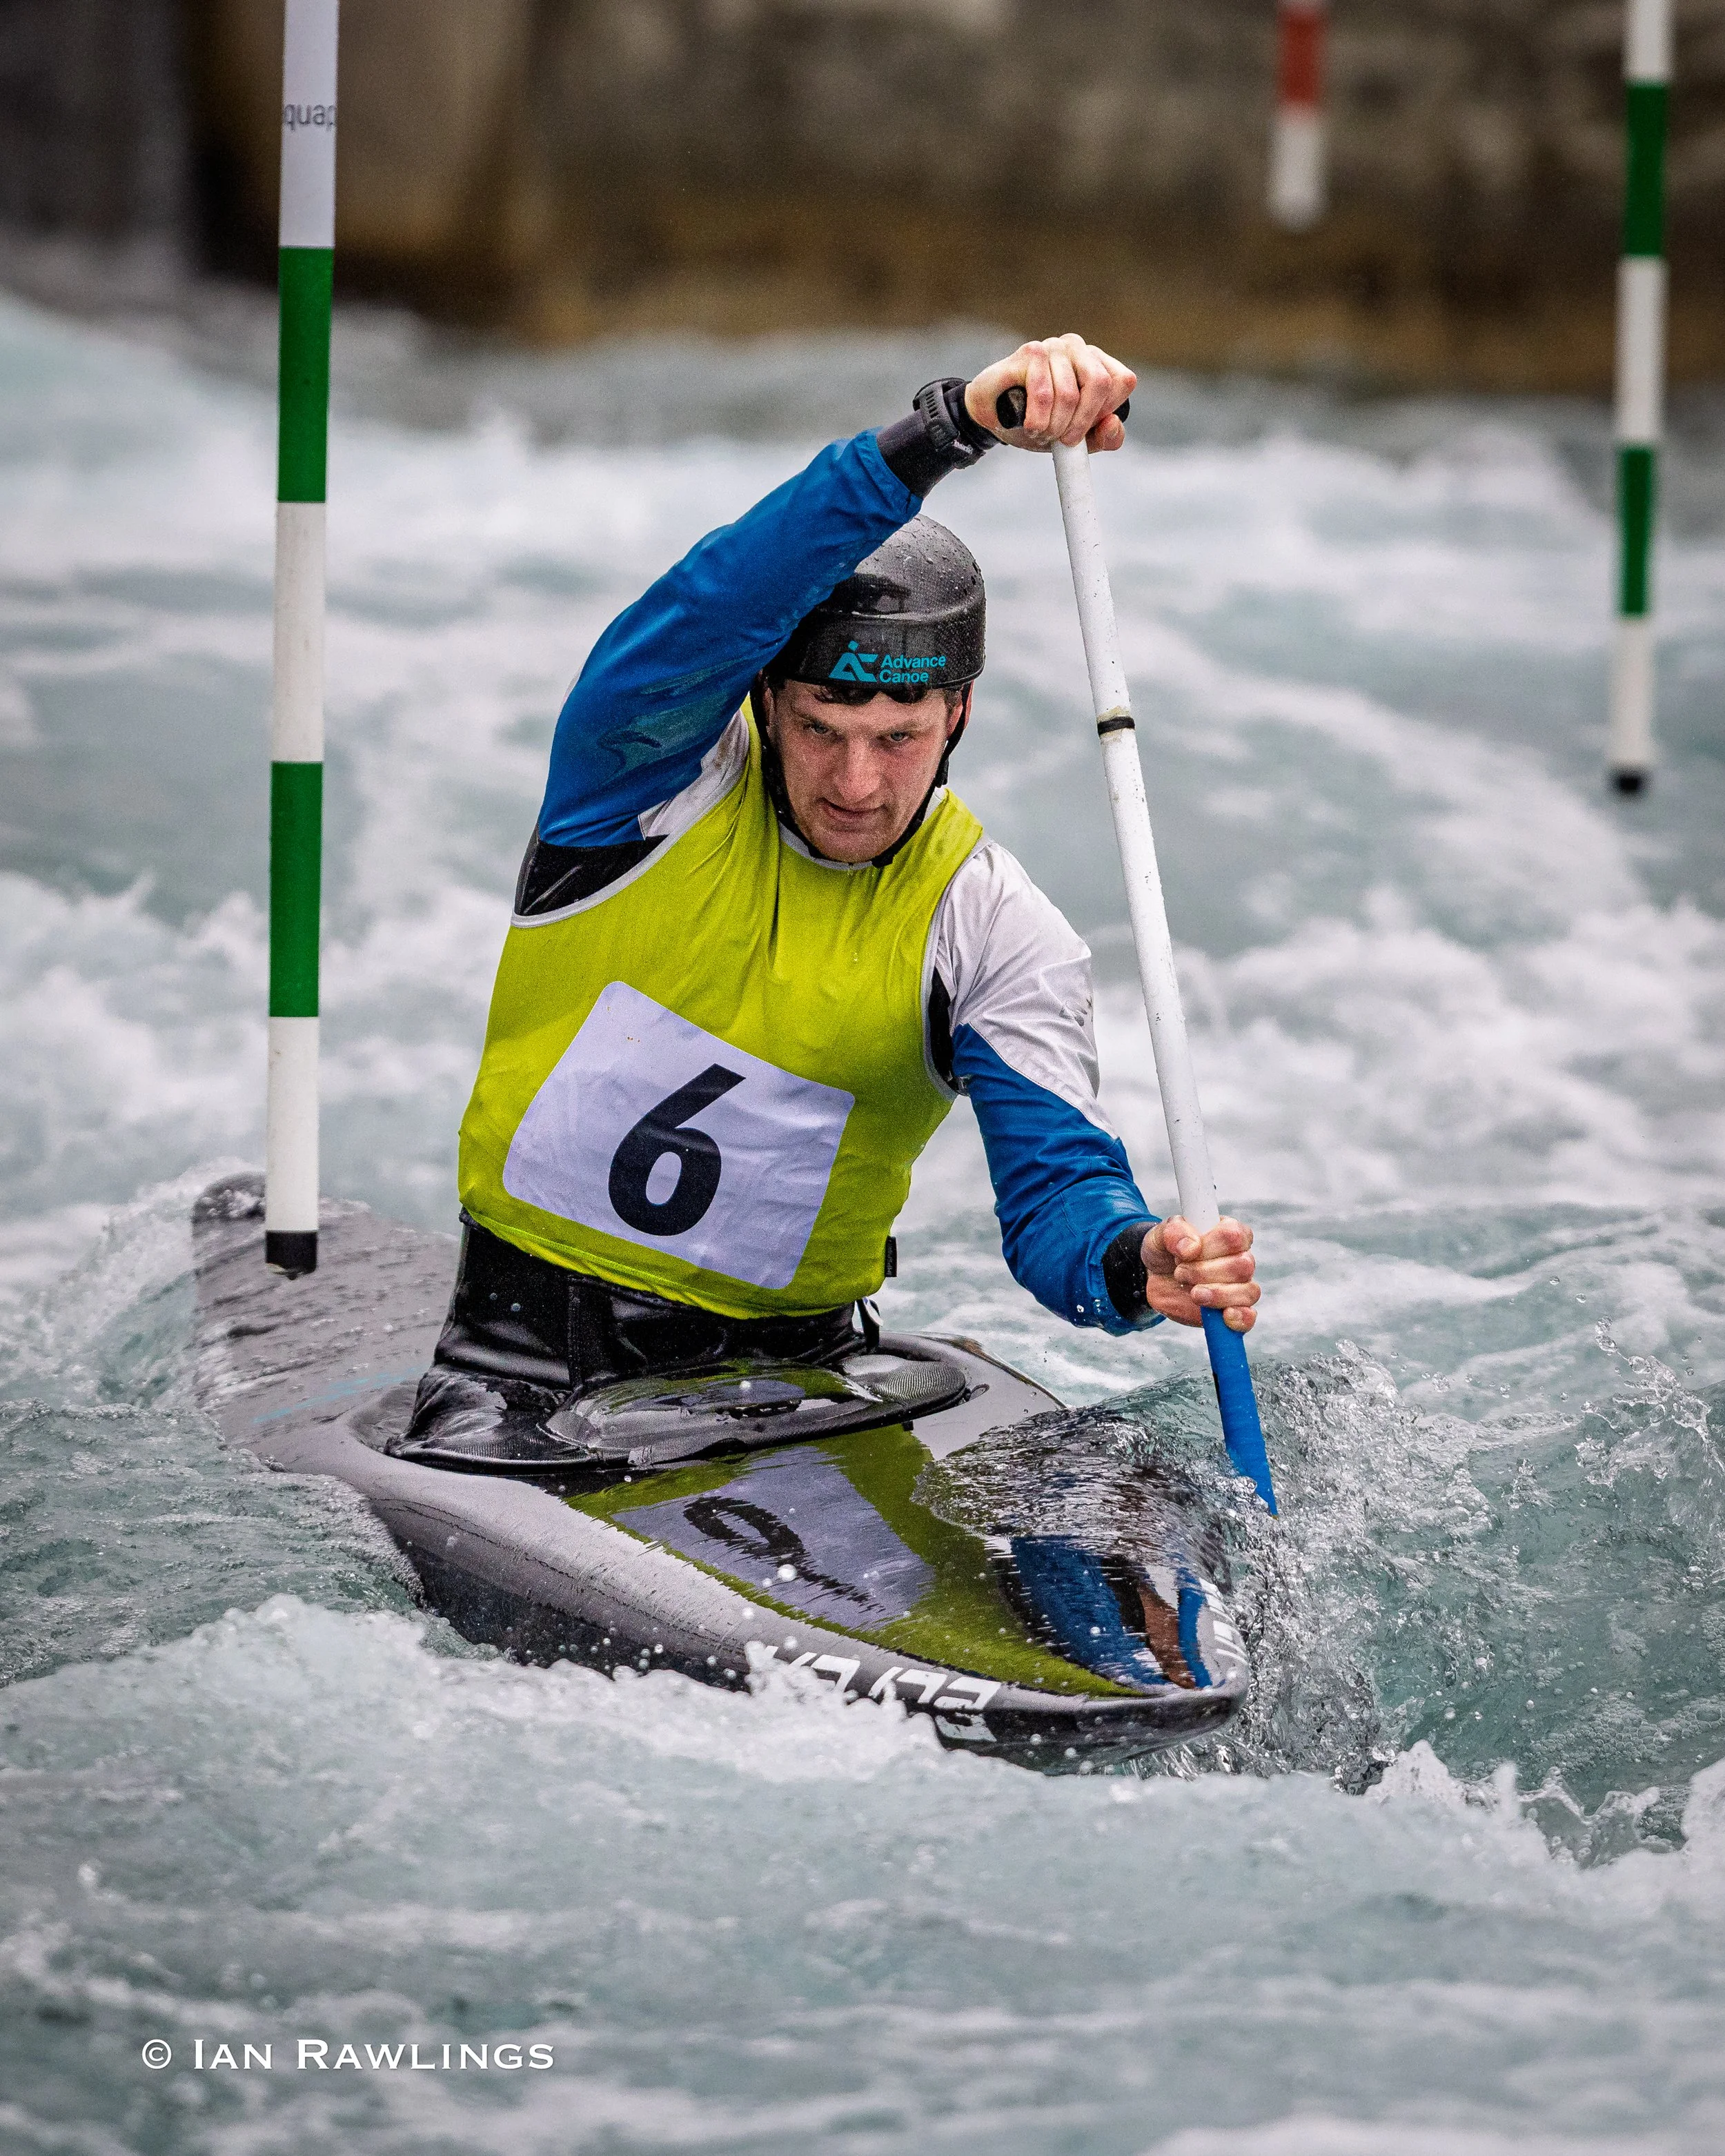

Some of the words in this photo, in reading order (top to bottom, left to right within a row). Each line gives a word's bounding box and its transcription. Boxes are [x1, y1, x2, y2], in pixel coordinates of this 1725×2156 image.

[880, 654, 947, 669] Advance
[879, 670, 929, 684] Canoe
[608, 1063, 747, 1237] 6
